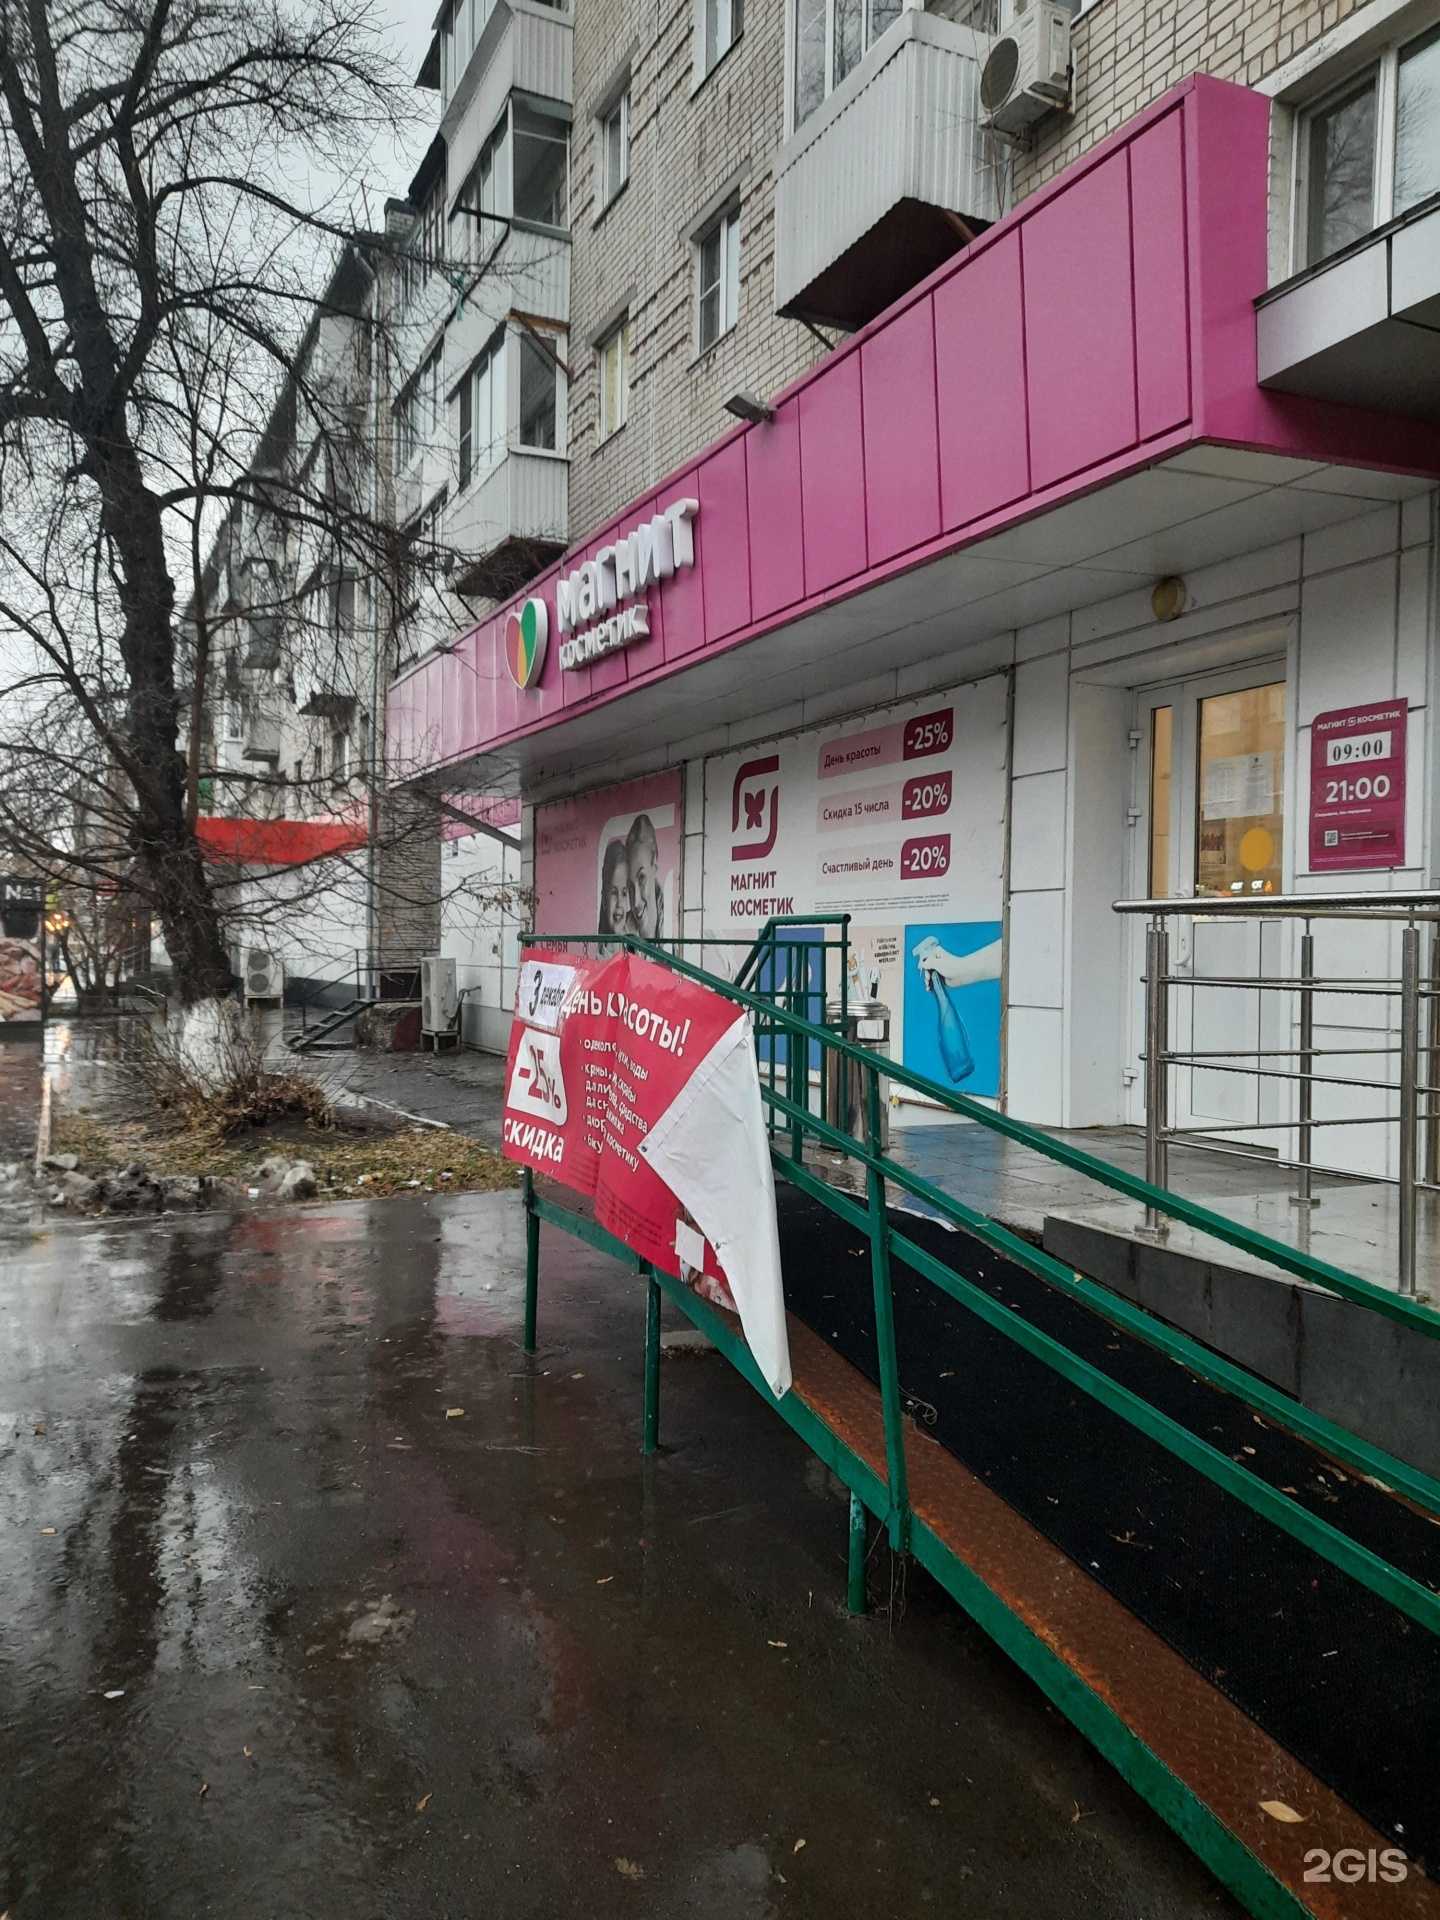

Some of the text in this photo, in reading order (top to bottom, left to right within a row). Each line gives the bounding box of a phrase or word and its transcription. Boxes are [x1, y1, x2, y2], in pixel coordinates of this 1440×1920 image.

[824, 721, 948, 769] День красоты -25%
[1333, 739, 1383, 761] 09:00
[823, 782, 948, 821] Скидка 15 числа -20%
[1326, 775, 1391, 803] 21:00
[822, 844, 947, 875] Счастливый день -20%
[730, 871, 777, 891] МАГНИТ
[730, 896, 795, 917] КОСМЕТИК
[529, 969, 543, 1016] 3
